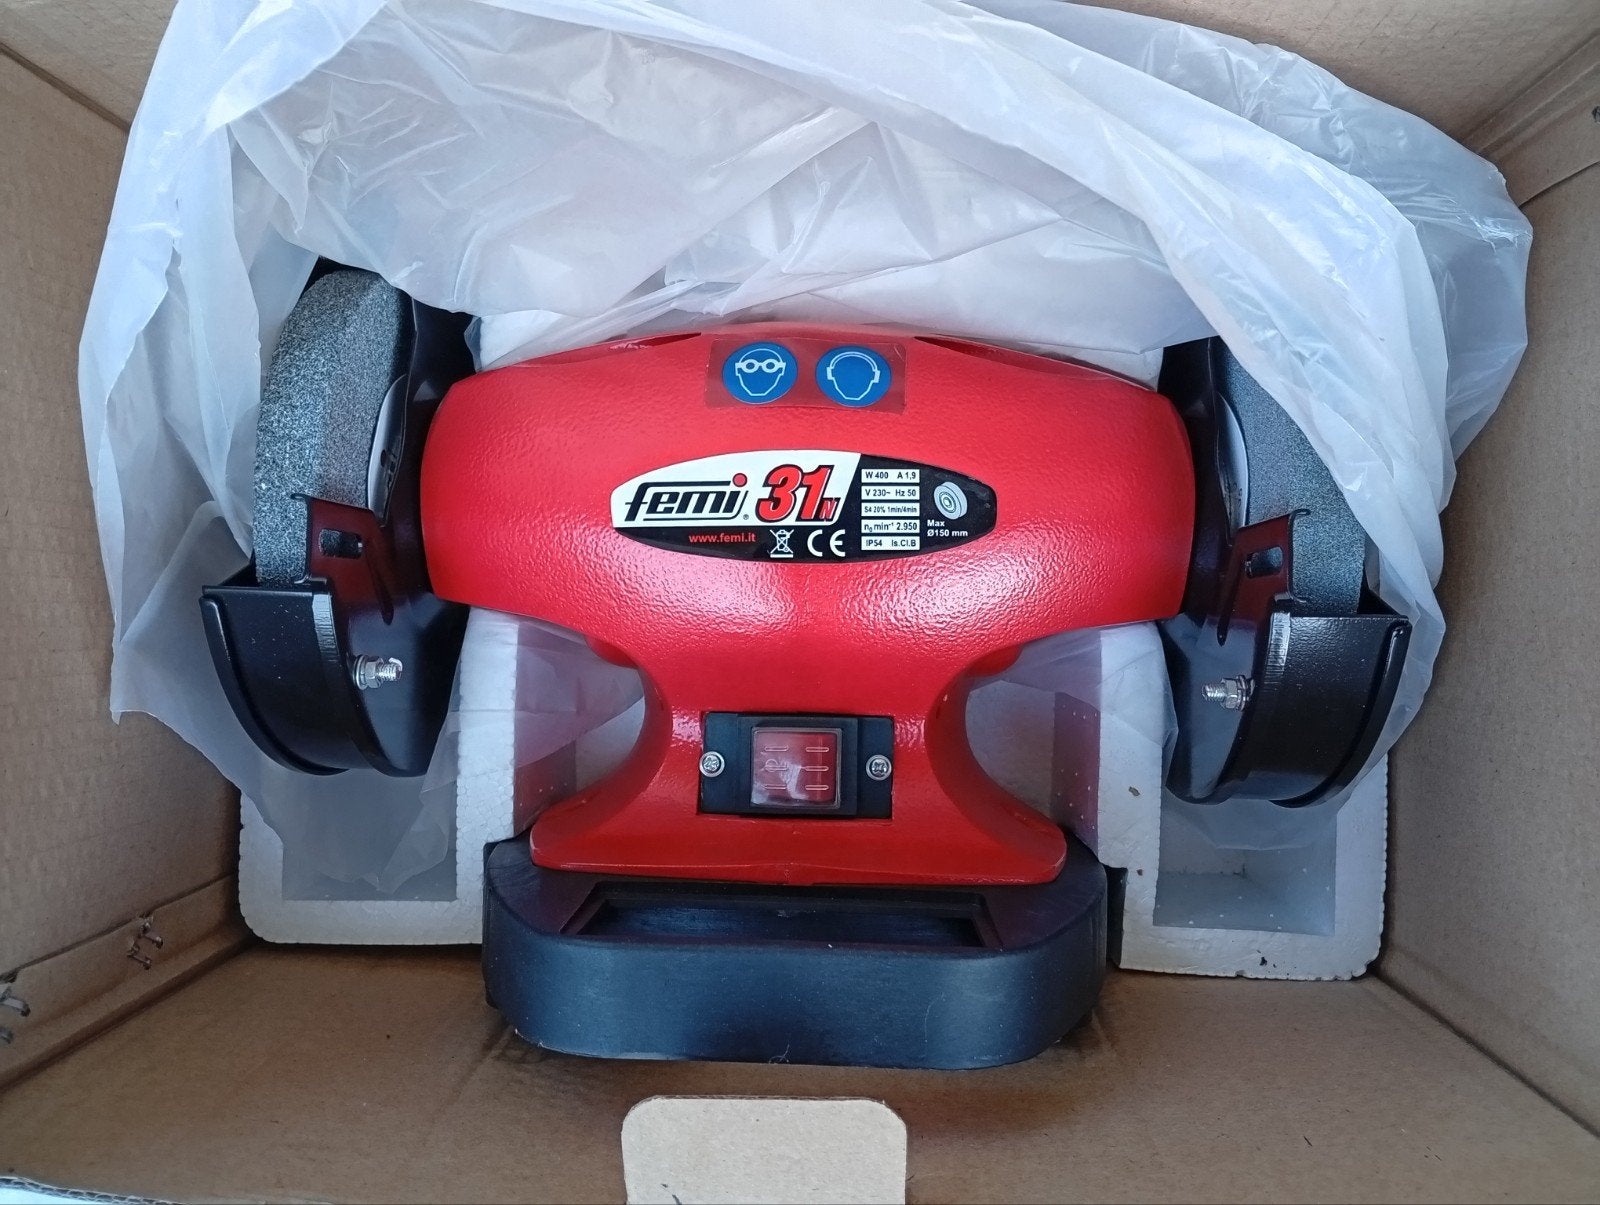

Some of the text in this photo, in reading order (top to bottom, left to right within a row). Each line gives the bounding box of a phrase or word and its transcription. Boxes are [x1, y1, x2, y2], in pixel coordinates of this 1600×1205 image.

[905, 472, 916, 480] 1,9
[624, 473, 748, 521] femi
[689, 533, 756, 543] www.femi.it
